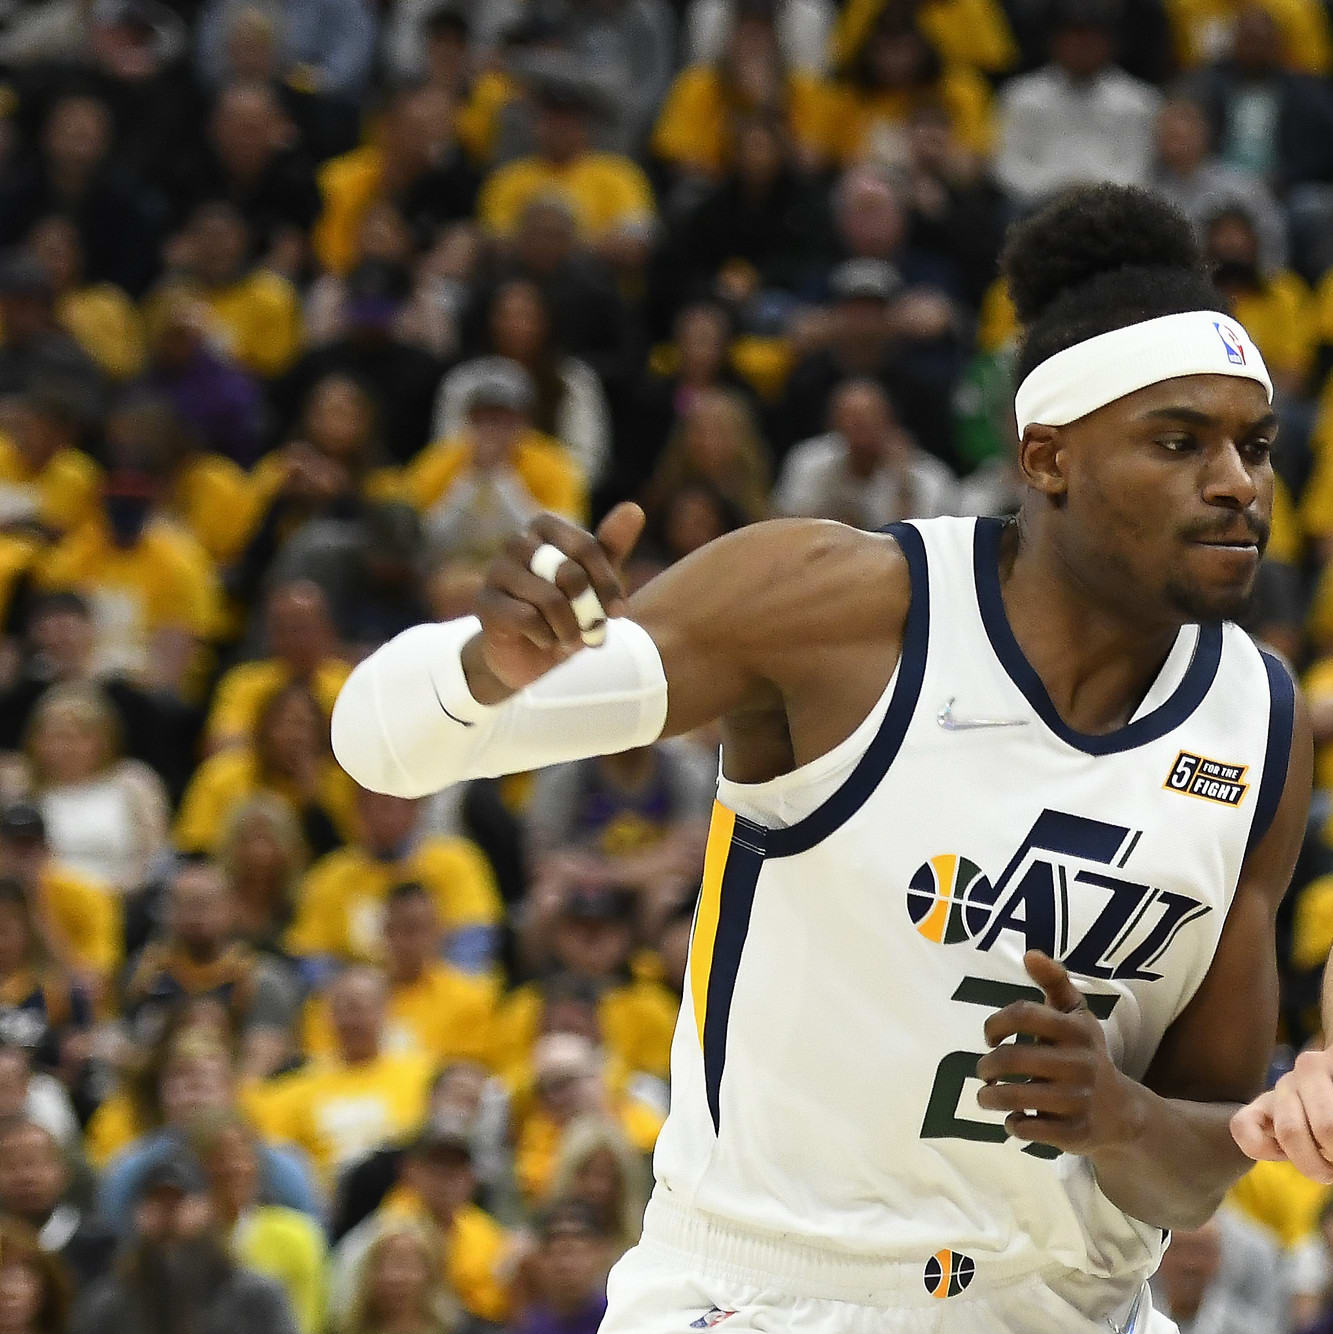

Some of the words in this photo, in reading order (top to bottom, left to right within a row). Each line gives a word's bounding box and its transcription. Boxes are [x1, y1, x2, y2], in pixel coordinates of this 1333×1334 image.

[1171, 756, 1196, 788] 5
[1202, 762, 1220, 775] FOR
[1221, 766, 1239, 779] THE
[1193, 778, 1241, 802] FIGHT
